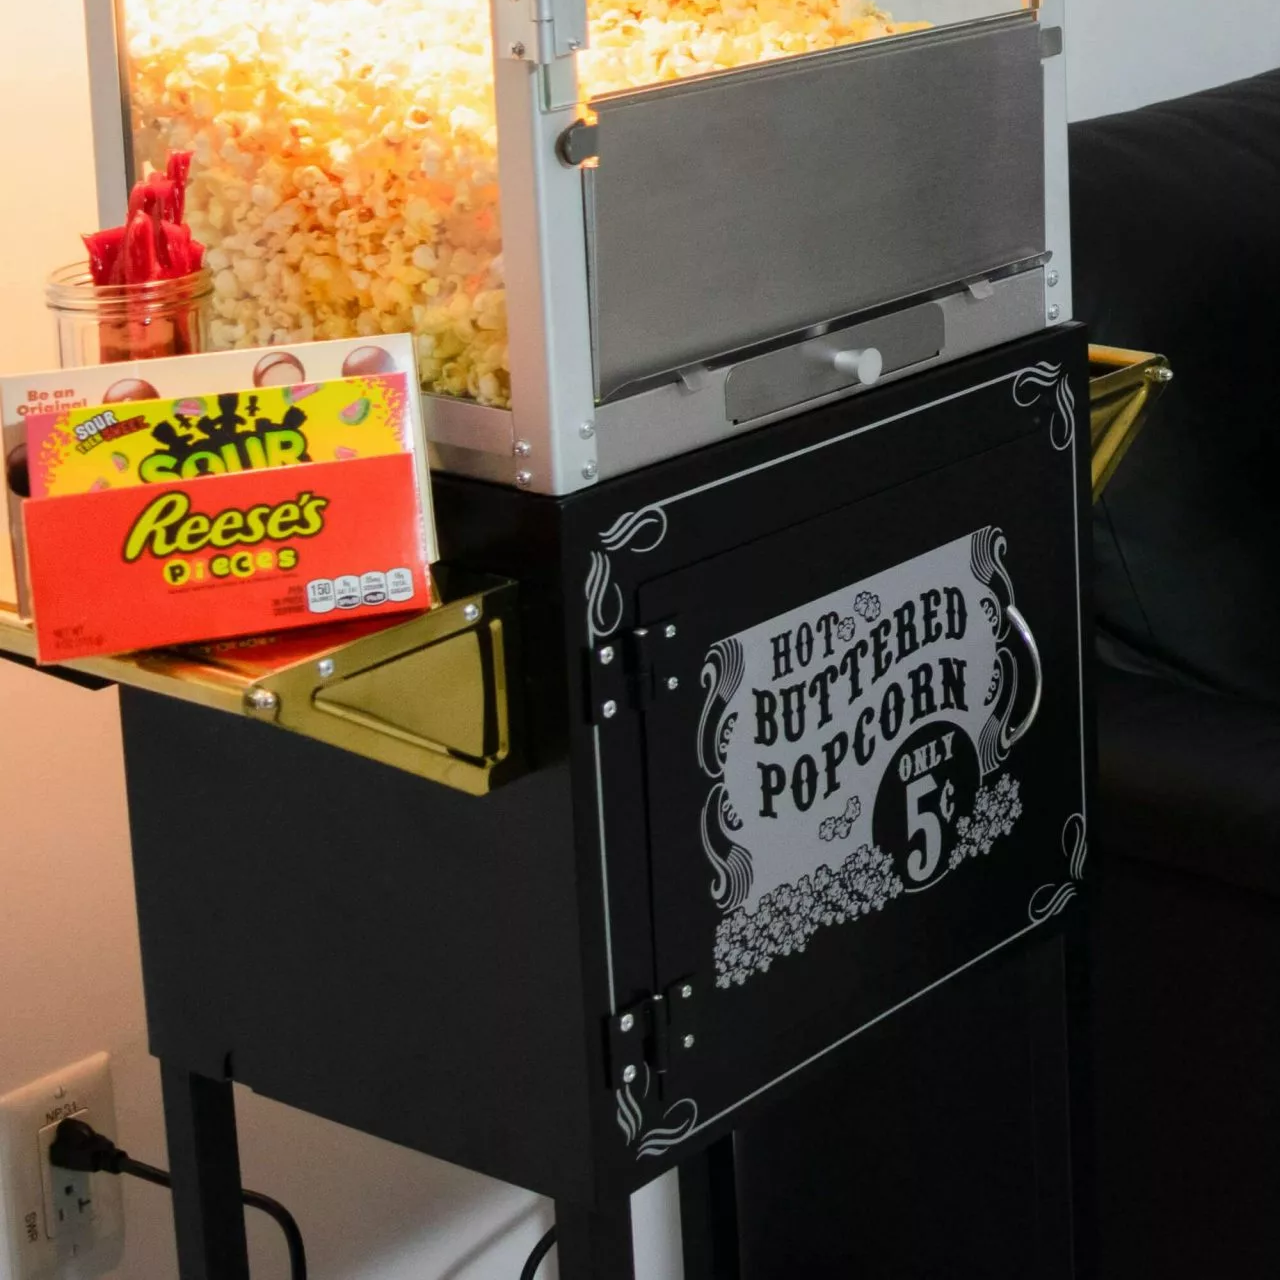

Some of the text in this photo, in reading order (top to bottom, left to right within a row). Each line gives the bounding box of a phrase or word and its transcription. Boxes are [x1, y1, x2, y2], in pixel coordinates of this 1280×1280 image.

[27, 388, 75, 402] Be an
[75, 410, 118, 440] SOUR
[123, 491, 329, 564] Reese's
[311, 582, 331, 596] 150
[752, 586, 968, 747] BUTTERED
[769, 610, 840, 681] HOT
[756, 657, 969, 819] POPCORN
[898, 731, 956, 782] ONLY
[905, 773, 955, 883] 5¢
